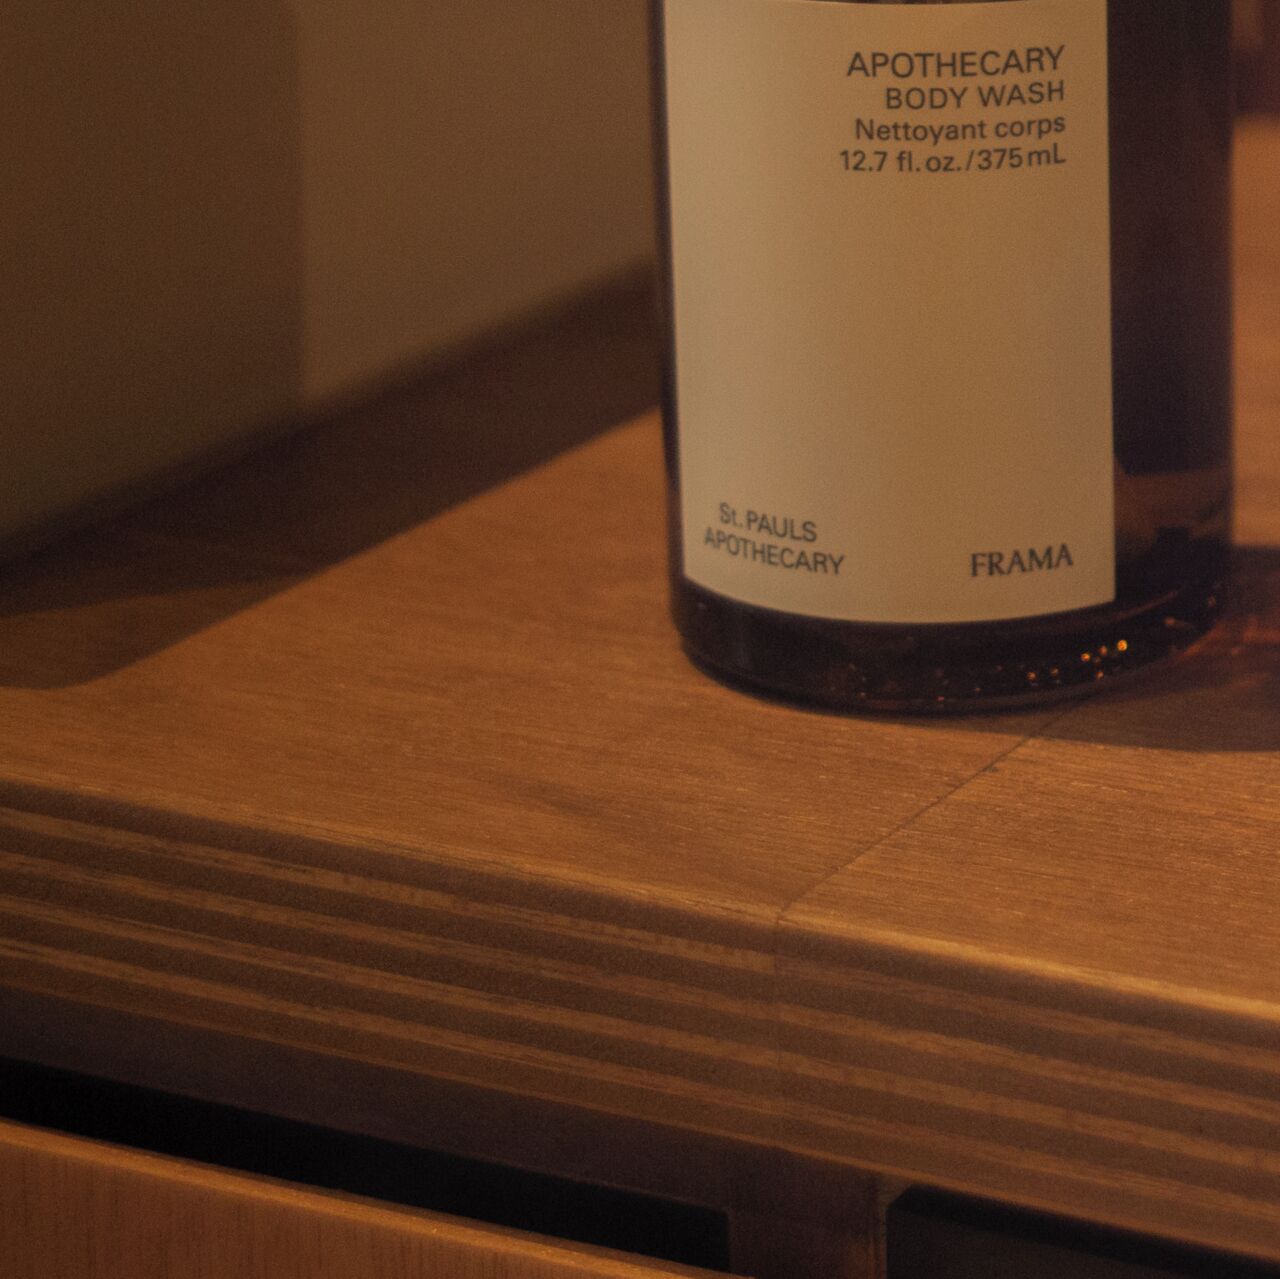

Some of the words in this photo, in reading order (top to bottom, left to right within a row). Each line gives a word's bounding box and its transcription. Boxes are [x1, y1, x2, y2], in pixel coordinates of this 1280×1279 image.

[846, 44, 1065, 79] APOTHECARY
[885, 86, 969, 111] BODY
[977, 79, 1065, 108] WASH
[854, 117, 988, 147] Nettoyant
[993, 116, 1066, 141] corps
[703, 526, 846, 576] APOTHECARY
[970, 542, 1075, 578] FRAMA
